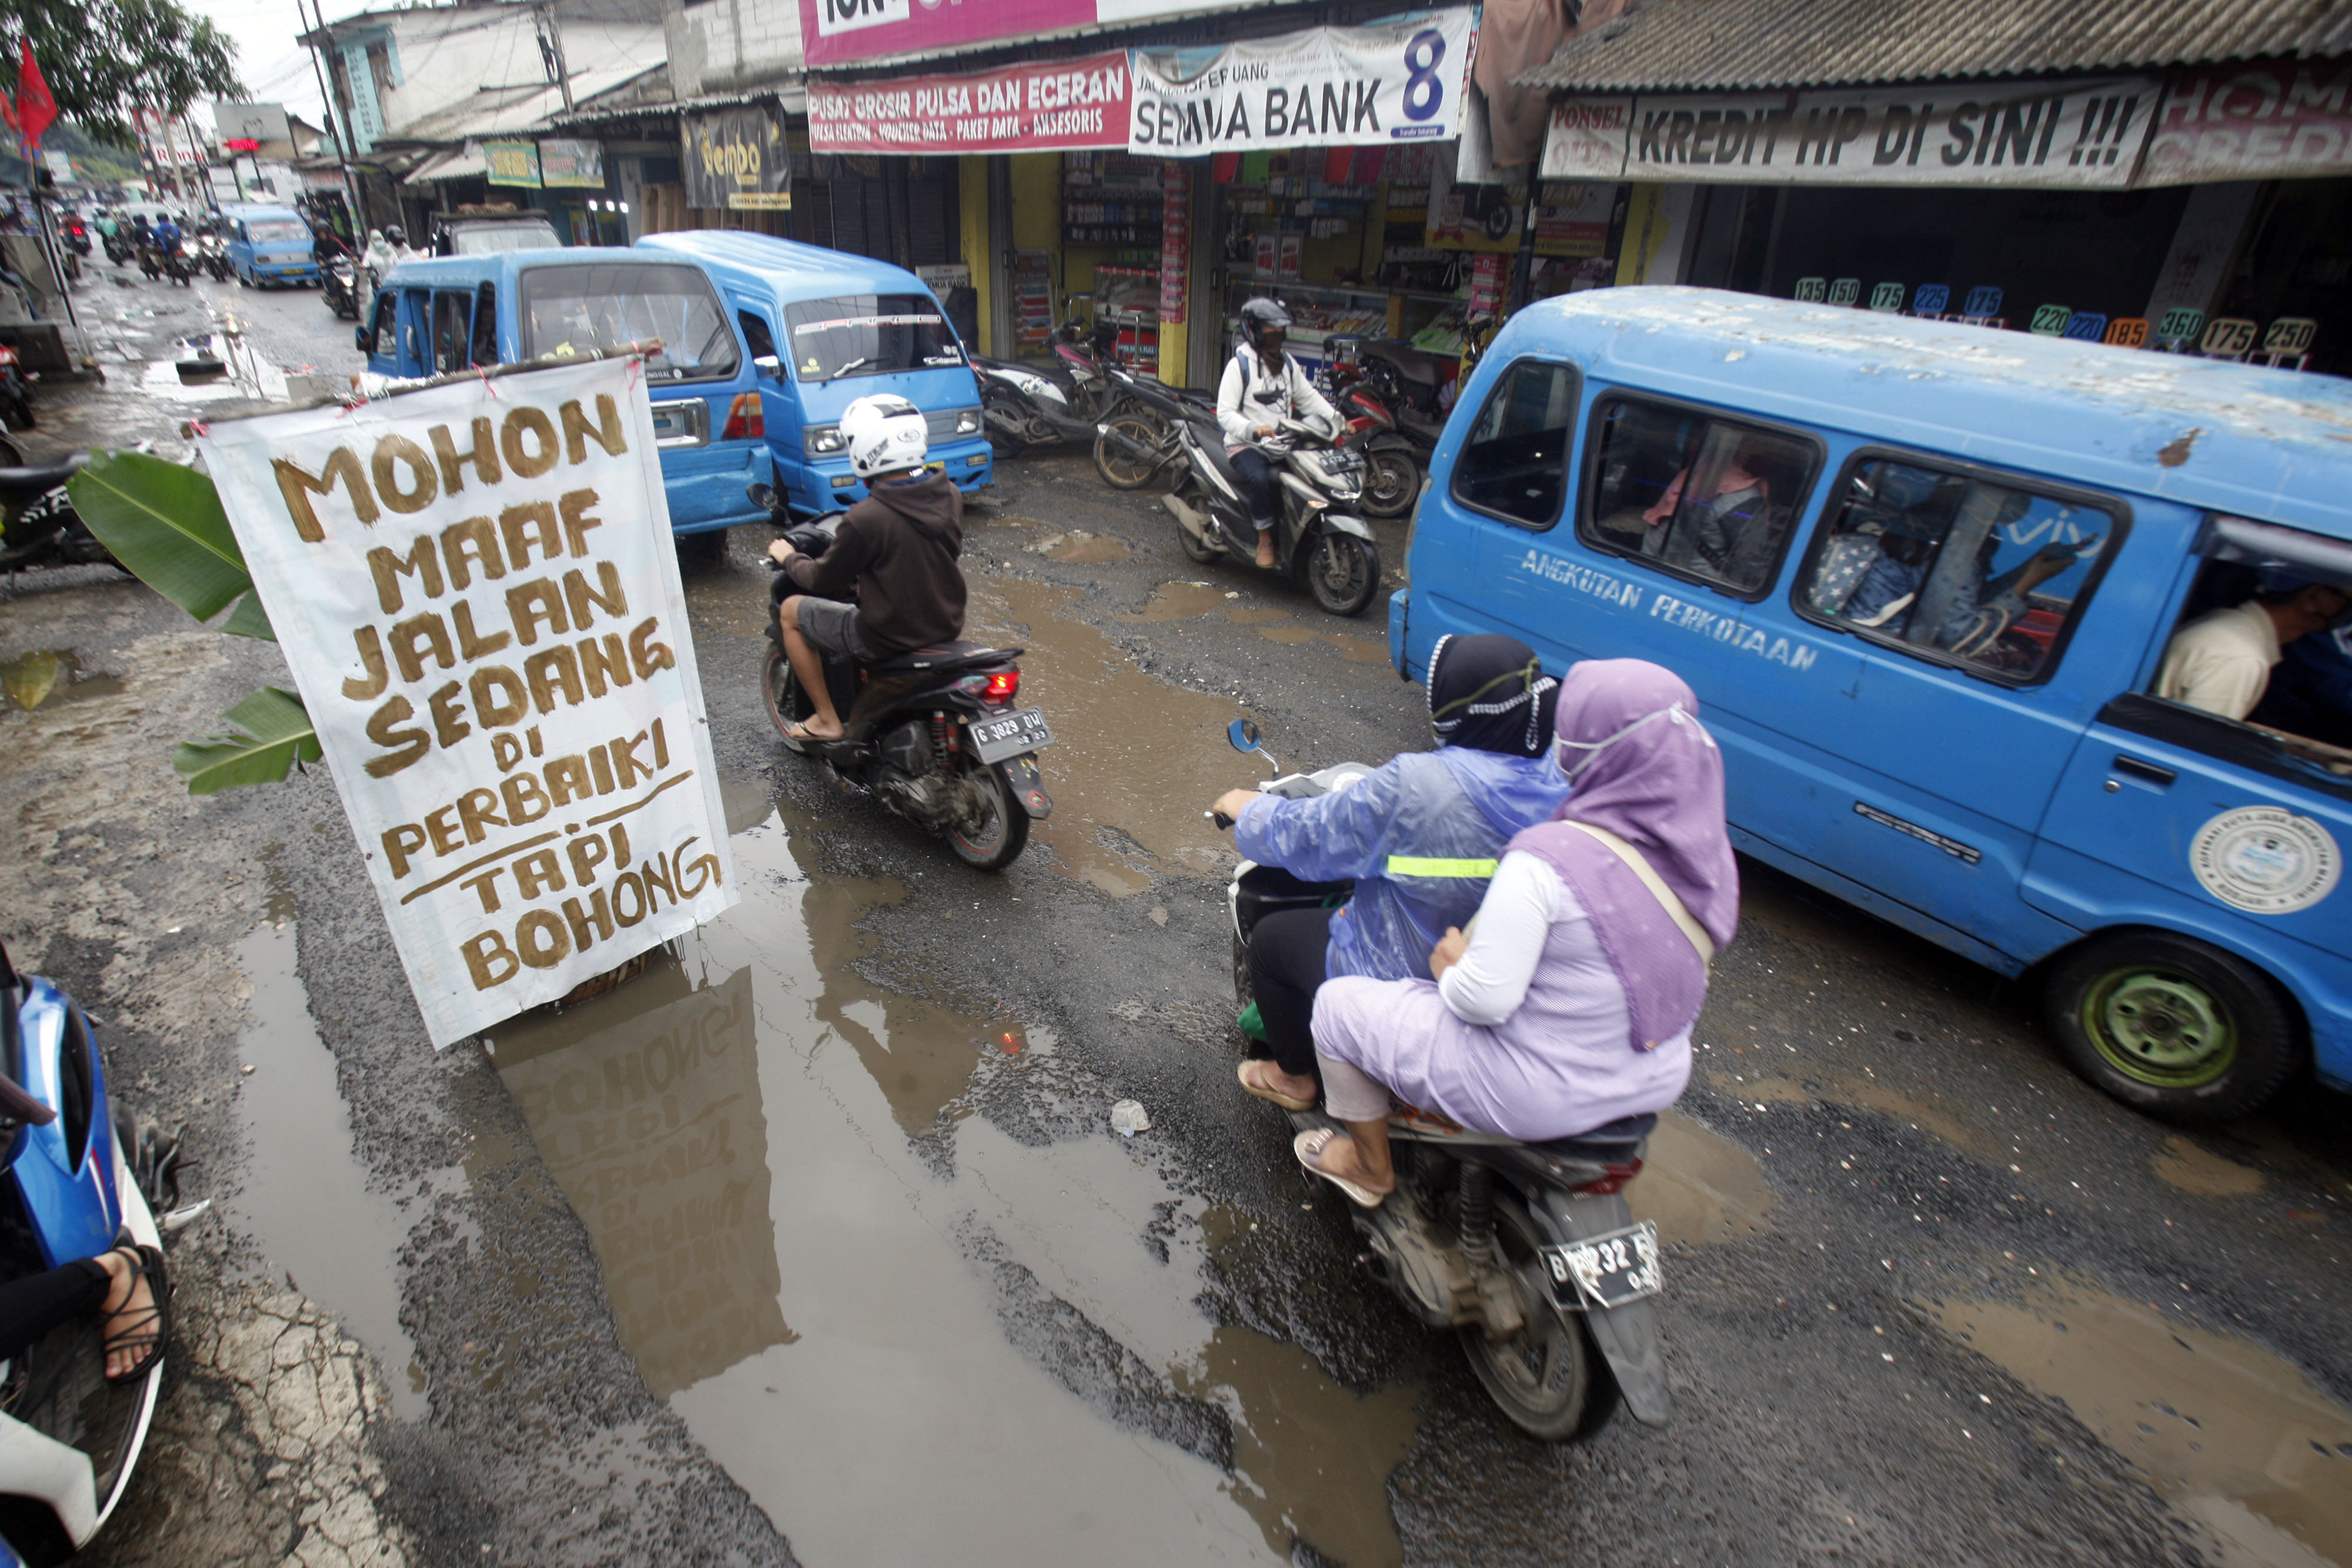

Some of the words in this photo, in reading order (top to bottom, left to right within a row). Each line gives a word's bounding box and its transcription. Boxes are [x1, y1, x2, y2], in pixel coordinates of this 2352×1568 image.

[1232, 62, 1269, 82] UANG
[1402, 29, 1446, 121] 8
[856, 91, 911, 120] GROSIR
[916, 86, 972, 118] PULSA
[978, 78, 1020, 114] DAN
[1028, 66, 1123, 110] ECERAN
[922, 120, 947, 142] DATA
[957, 117, 989, 141] PAKET
[992, 116, 1021, 139] DATA
[1034, 108, 1103, 137] AKSESORIS
[1135, 92, 1251, 146] SEMUA
[1265, 78, 1381, 137] BANK
[1553, 106, 1625, 131] PONSEL
[1638, 108, 1792, 164] KREDIT
[1795, 106, 1866, 165] HP
[1873, 103, 1933, 165] DI
[1941, 97, 2063, 166] SINI
[2069, 96, 2139, 165] !!!
[1798, 279, 1823, 302] 135
[1830, 280, 1858, 303] 150
[1873, 285, 1903, 307] 175
[1916, 286, 1947, 309] 225
[1968, 289, 2002, 314] 175
[2033, 306, 2070, 333] 220
[2066, 314, 2104, 339] 220
[2109, 321, 2146, 345] 185
[2161, 310, 2203, 337] 360
[2206, 322, 2254, 350] 175
[2266, 321, 2314, 348] 250
[269, 392, 628, 543] MOHON
[366, 487, 602, 616] MAAF
[1521, 549, 1643, 609] ANGKUTAN
[342, 560, 629, 701] JALAN
[364, 617, 676, 778] SEDANG
[490, 724, 544, 773] DI
[381, 717, 670, 880] PERBAIKI
[459, 822, 632, 914] TAPI
[459, 835, 721, 991] BOHONG
